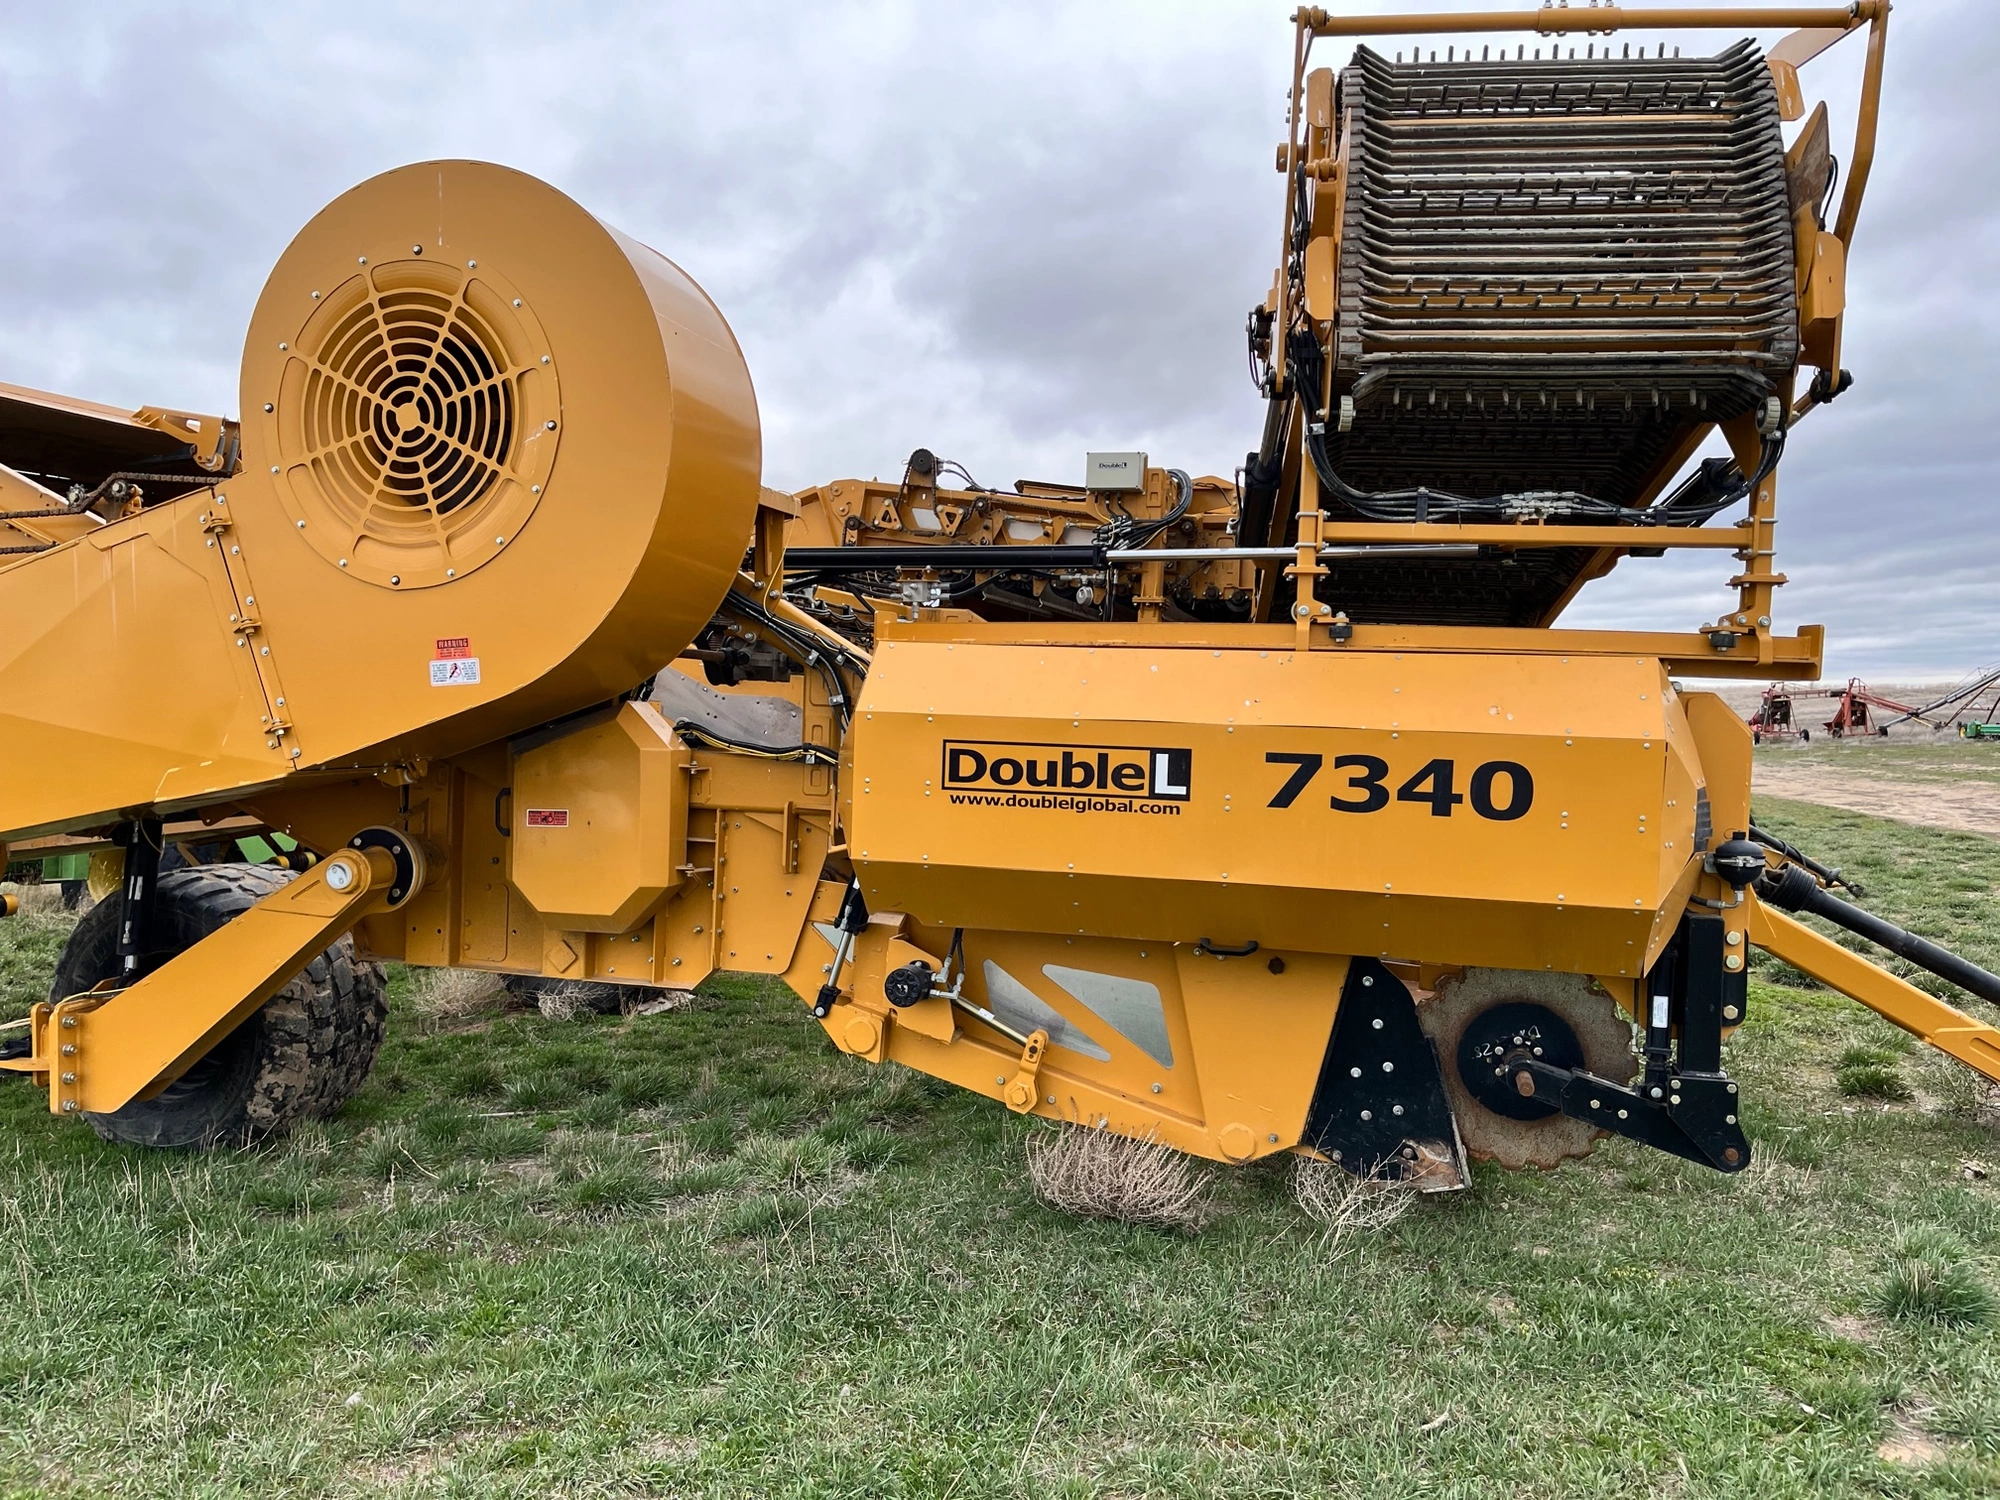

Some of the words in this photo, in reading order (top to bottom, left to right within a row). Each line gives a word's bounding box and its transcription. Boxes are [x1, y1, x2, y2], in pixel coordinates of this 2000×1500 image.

[438, 639, 467, 649] WARNING
[1265, 751, 1535, 822] 7340
[949, 793, 1181, 815] www.doublelglobal.com
